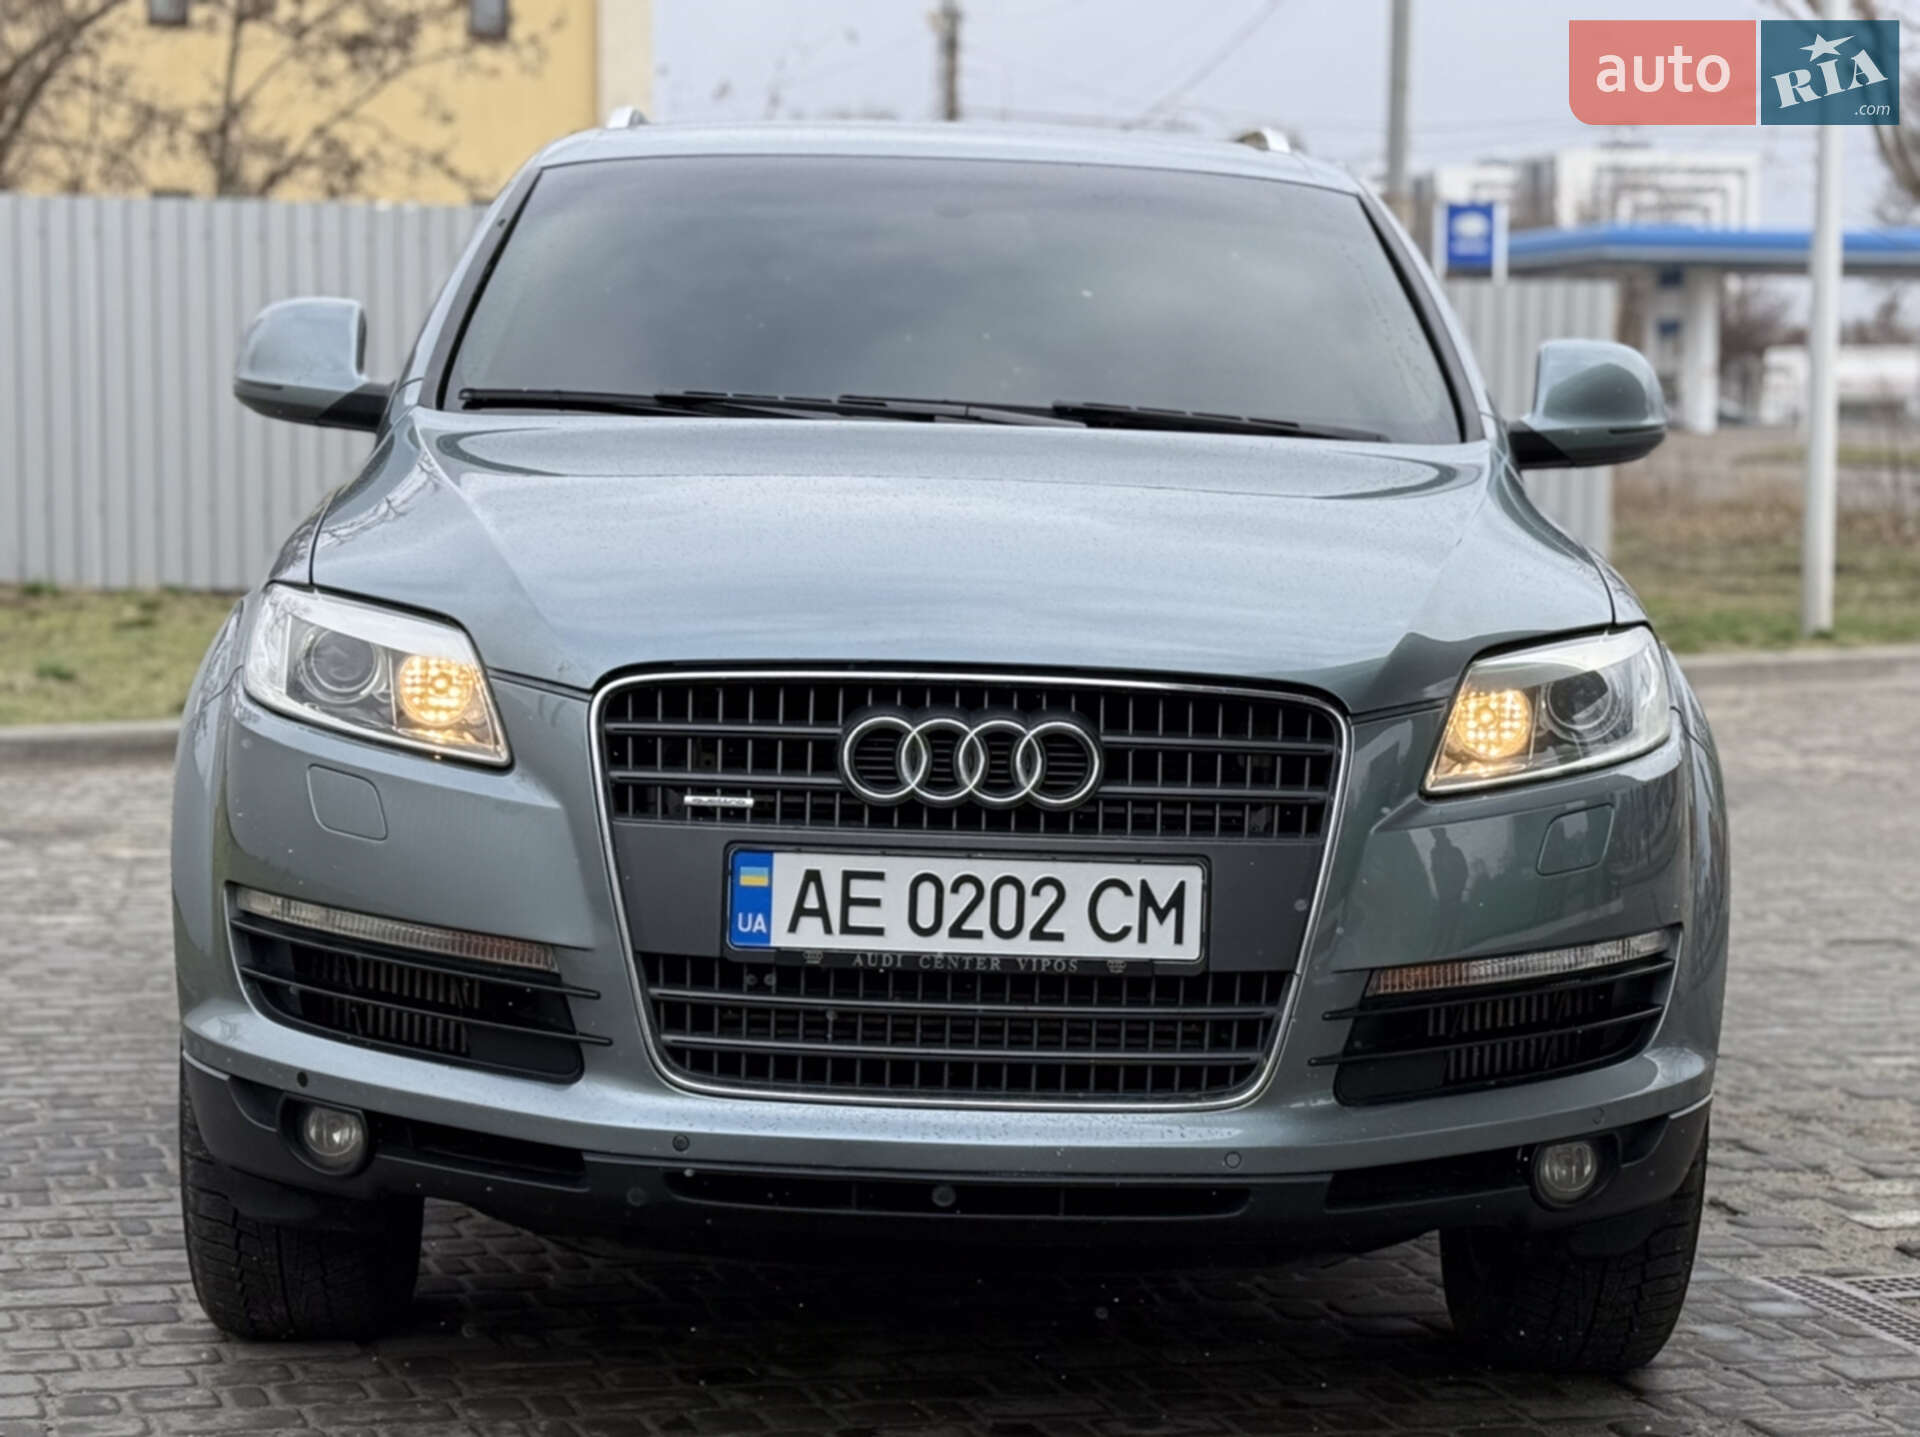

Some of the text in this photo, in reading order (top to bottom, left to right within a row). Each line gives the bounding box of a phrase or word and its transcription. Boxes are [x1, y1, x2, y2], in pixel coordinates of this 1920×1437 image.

[787, 868, 1186, 945] AE 0202 CM
[737, 912, 767, 933] UA
[852, 952, 1079, 973] AUDI CENTER VIPOS
